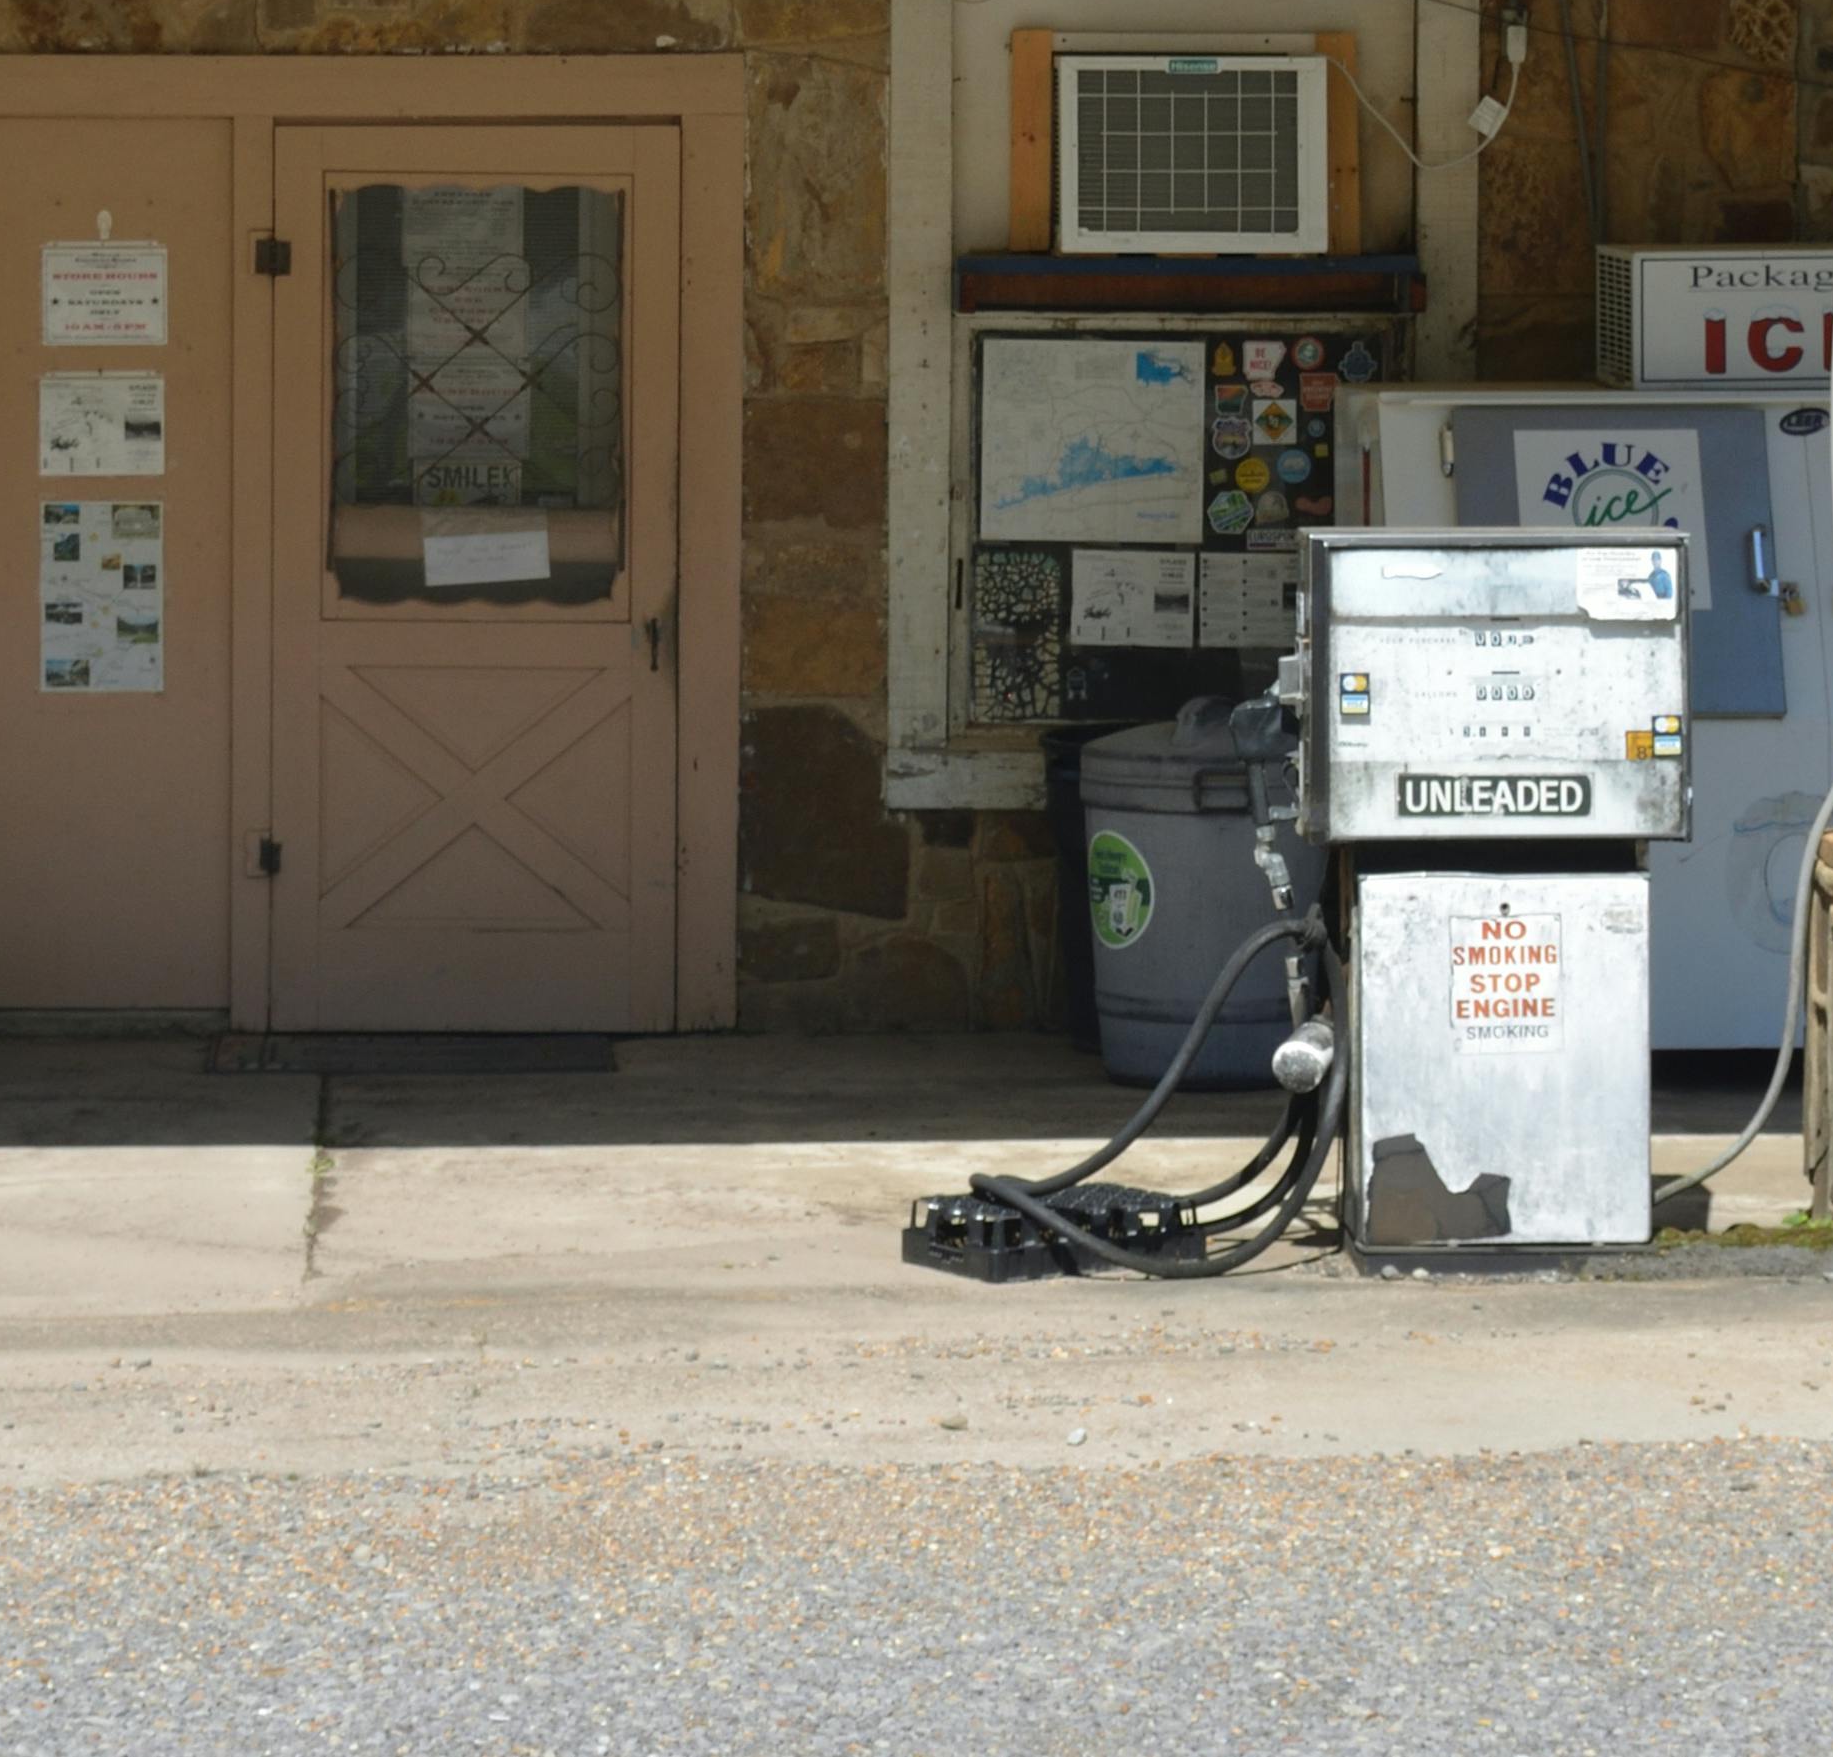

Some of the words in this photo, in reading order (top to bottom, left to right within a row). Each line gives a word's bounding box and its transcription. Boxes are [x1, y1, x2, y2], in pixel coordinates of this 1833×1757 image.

[53, 273, 104, 281] STORE
[105, 272, 158, 280] HOURS
[1786, 413, 1824, 429] LEER
[427, 466, 511, 489] SMILE!
[1543, 441, 1670, 510] BLUE
[1405, 778, 1583, 814] UNLEADED
[1481, 920, 1527, 941] NO
[1453, 944, 1557, 966] SMOKING
[1469, 972, 1541, 994] STOP
[1455, 998, 1556, 1020] ENGINE
[1466, 1024, 1549, 1041] SMOKING
